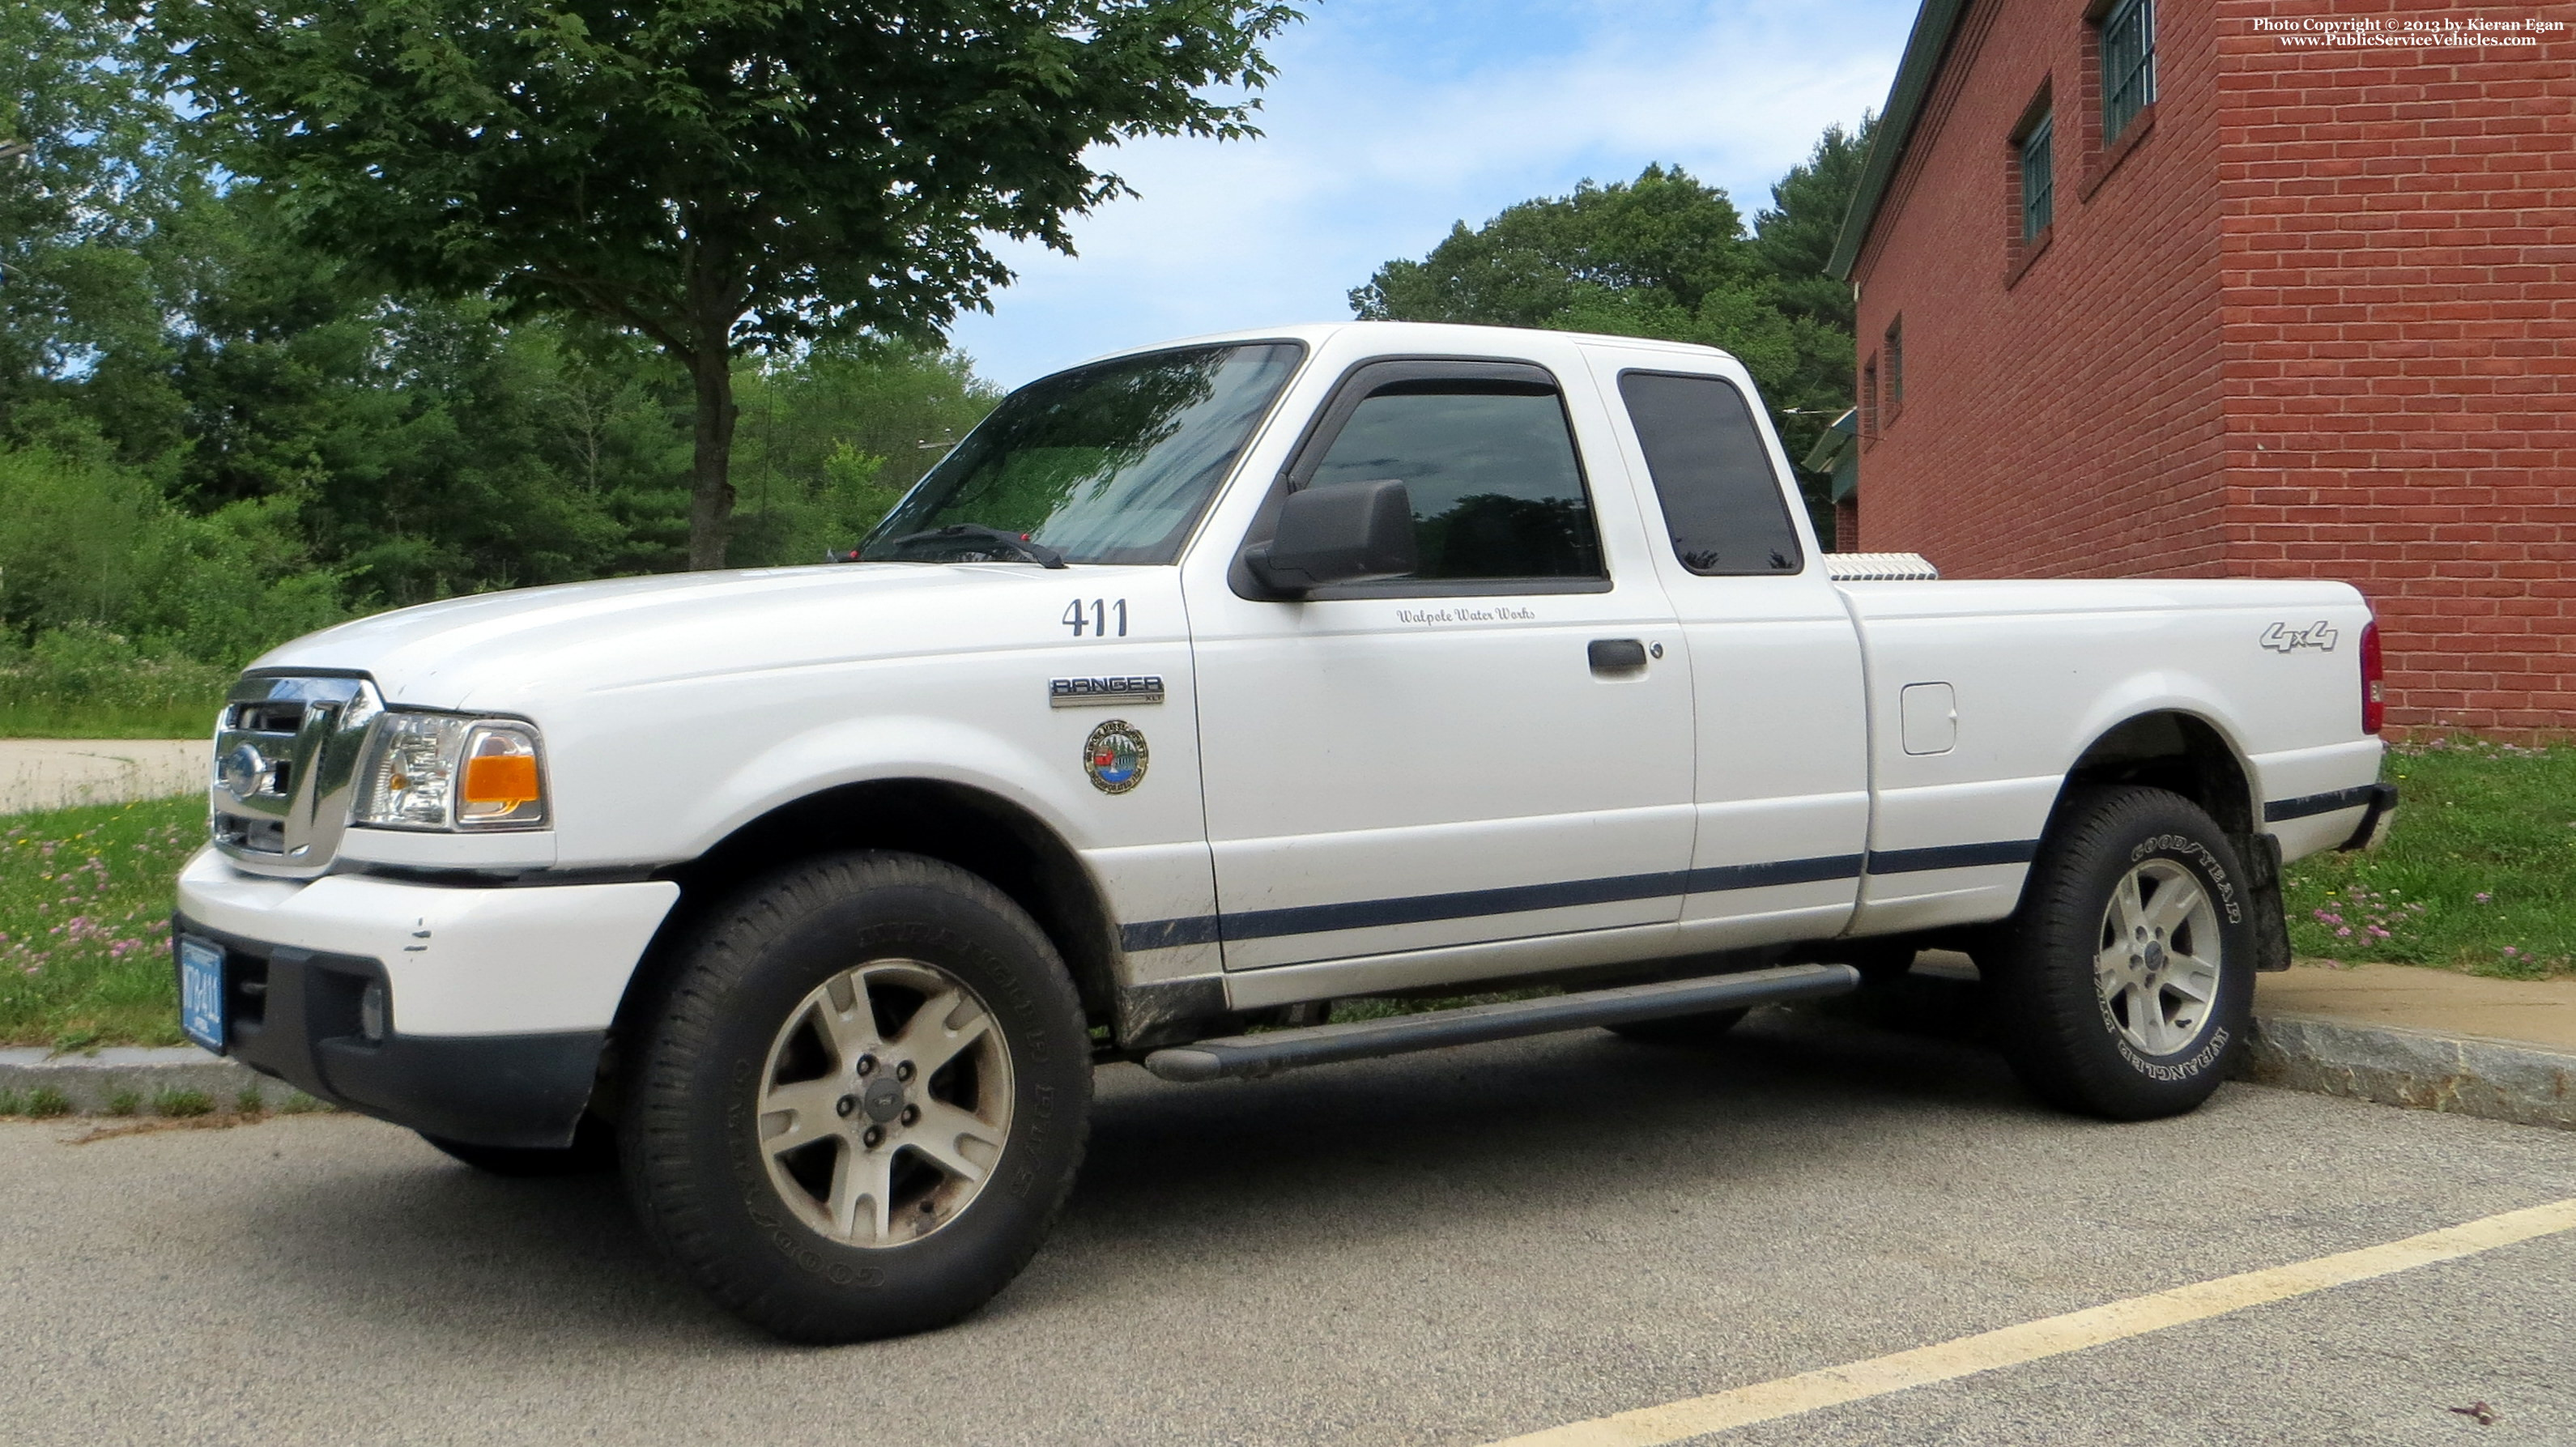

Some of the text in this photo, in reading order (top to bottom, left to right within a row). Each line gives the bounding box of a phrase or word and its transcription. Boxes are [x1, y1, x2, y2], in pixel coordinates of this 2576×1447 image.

[1062, 598, 1127, 637] 411
[1396, 606, 1535, 626] Walpole Water Works
[2259, 620, 2339, 653] 4x4
[1052, 676, 1163, 694] RANGER
[1144, 694, 1162, 702] XLT
[2118, 1026, 2230, 1082] WRANGLER
